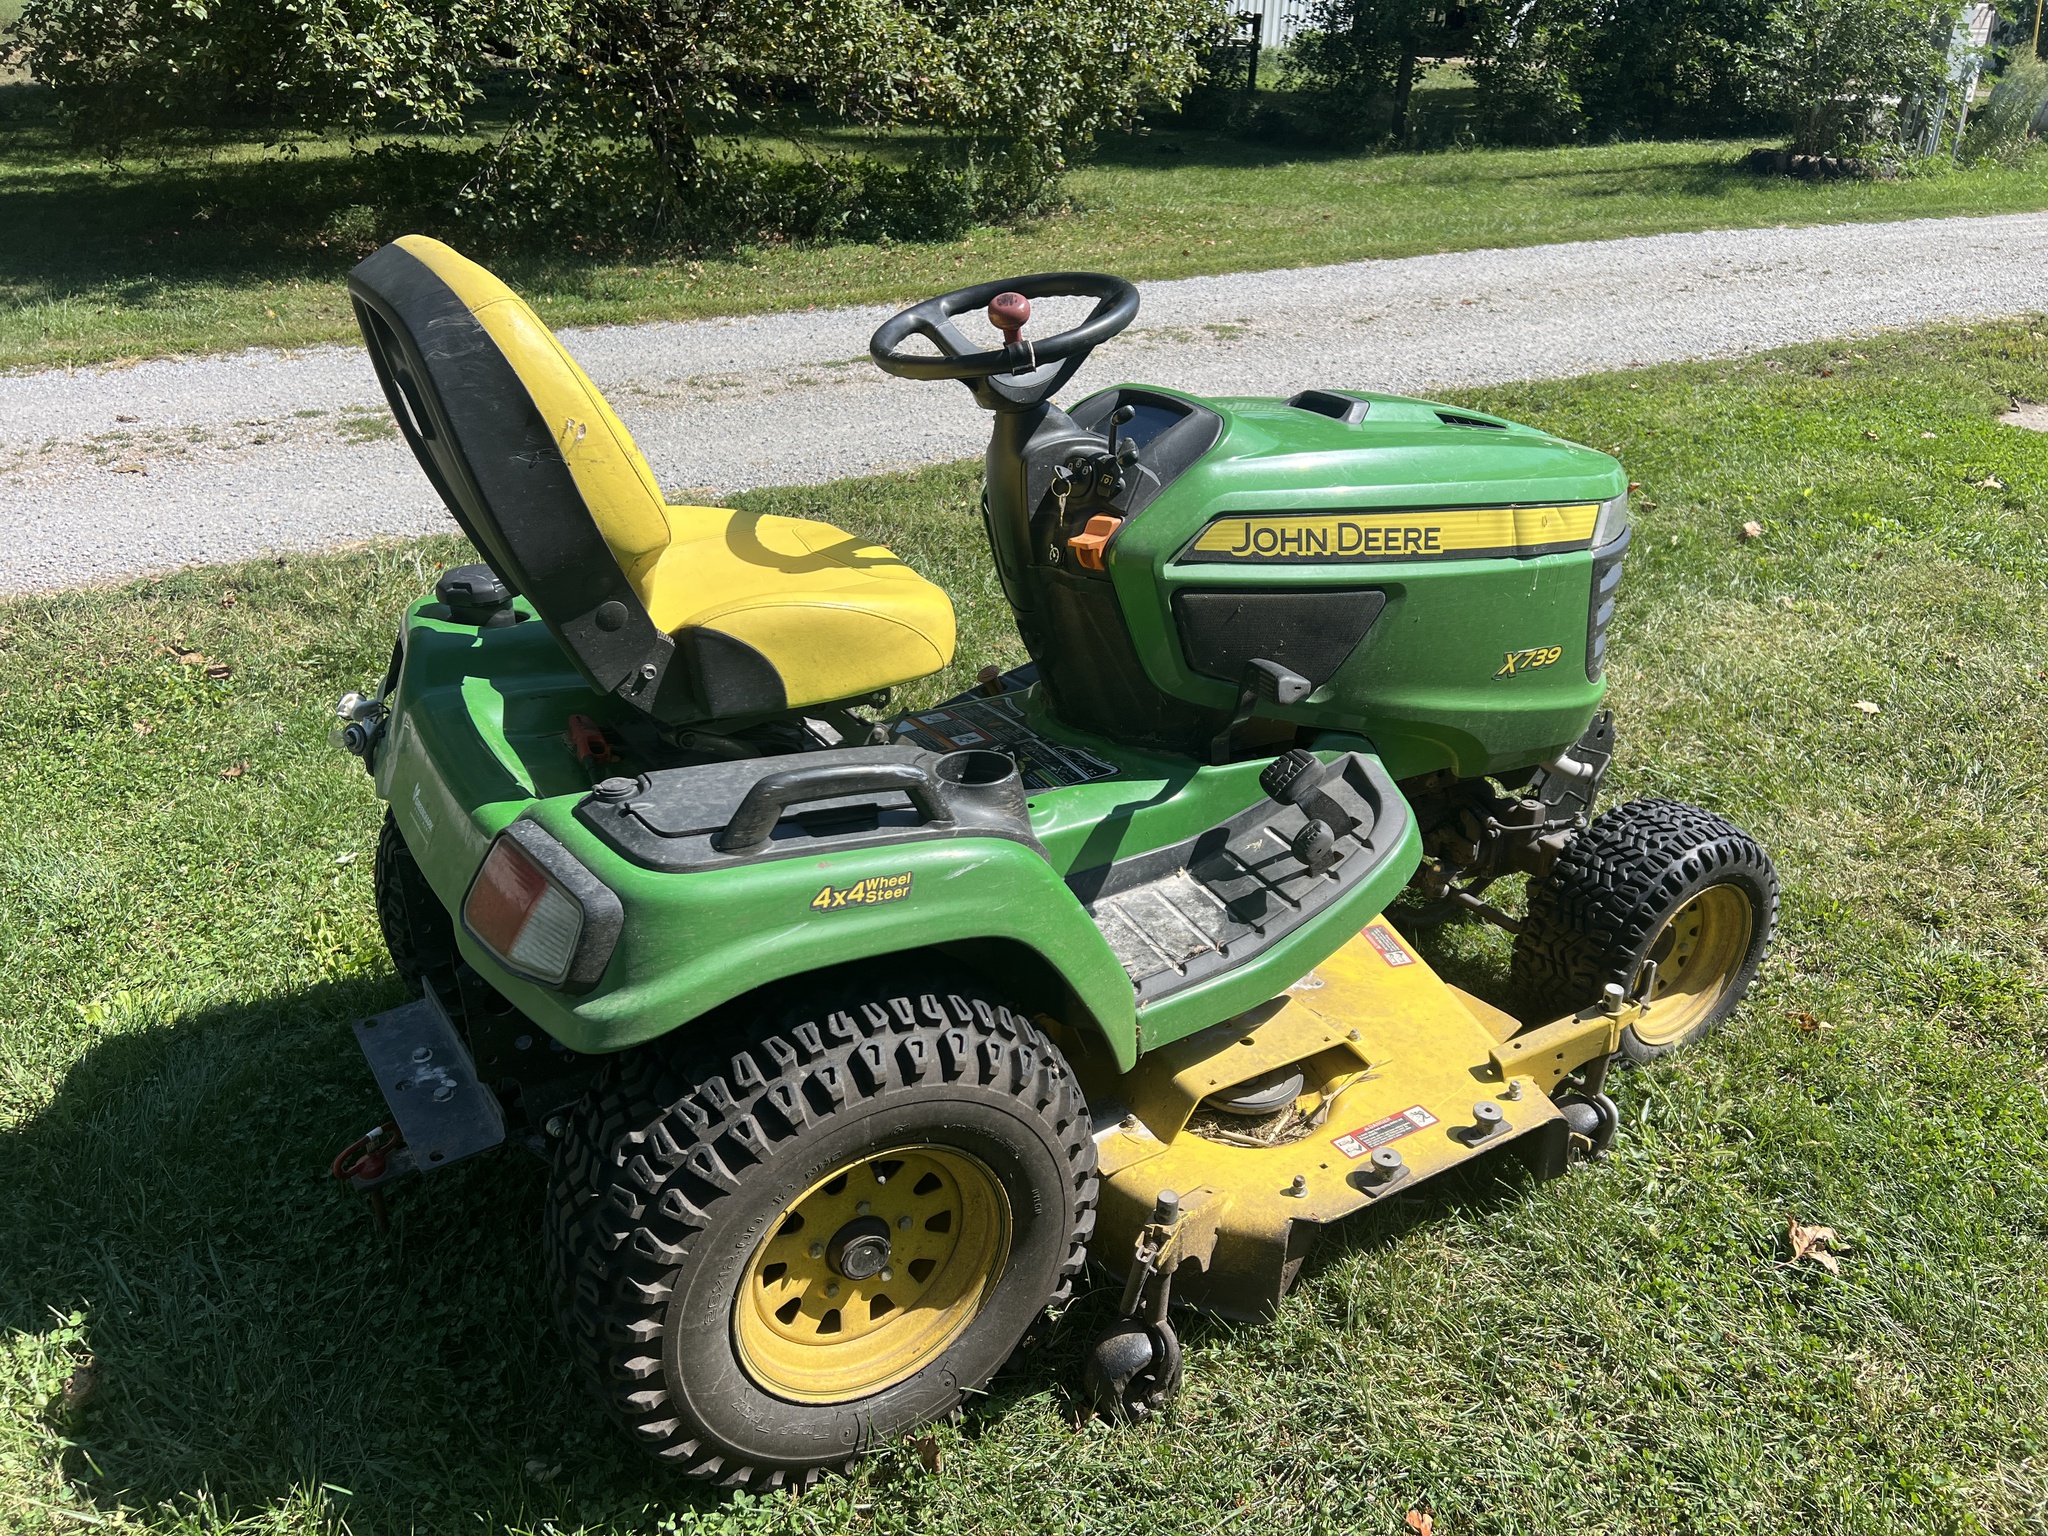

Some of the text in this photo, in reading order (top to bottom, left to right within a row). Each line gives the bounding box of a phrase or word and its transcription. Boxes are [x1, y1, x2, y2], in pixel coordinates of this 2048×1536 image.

[1231, 522, 1442, 555] JOHN DEERE
[1496, 646, 1562, 676] X739
[812, 881, 865, 908] 4x4
[865, 871, 912, 891] Wheel
[865, 886, 910, 904] Steer
